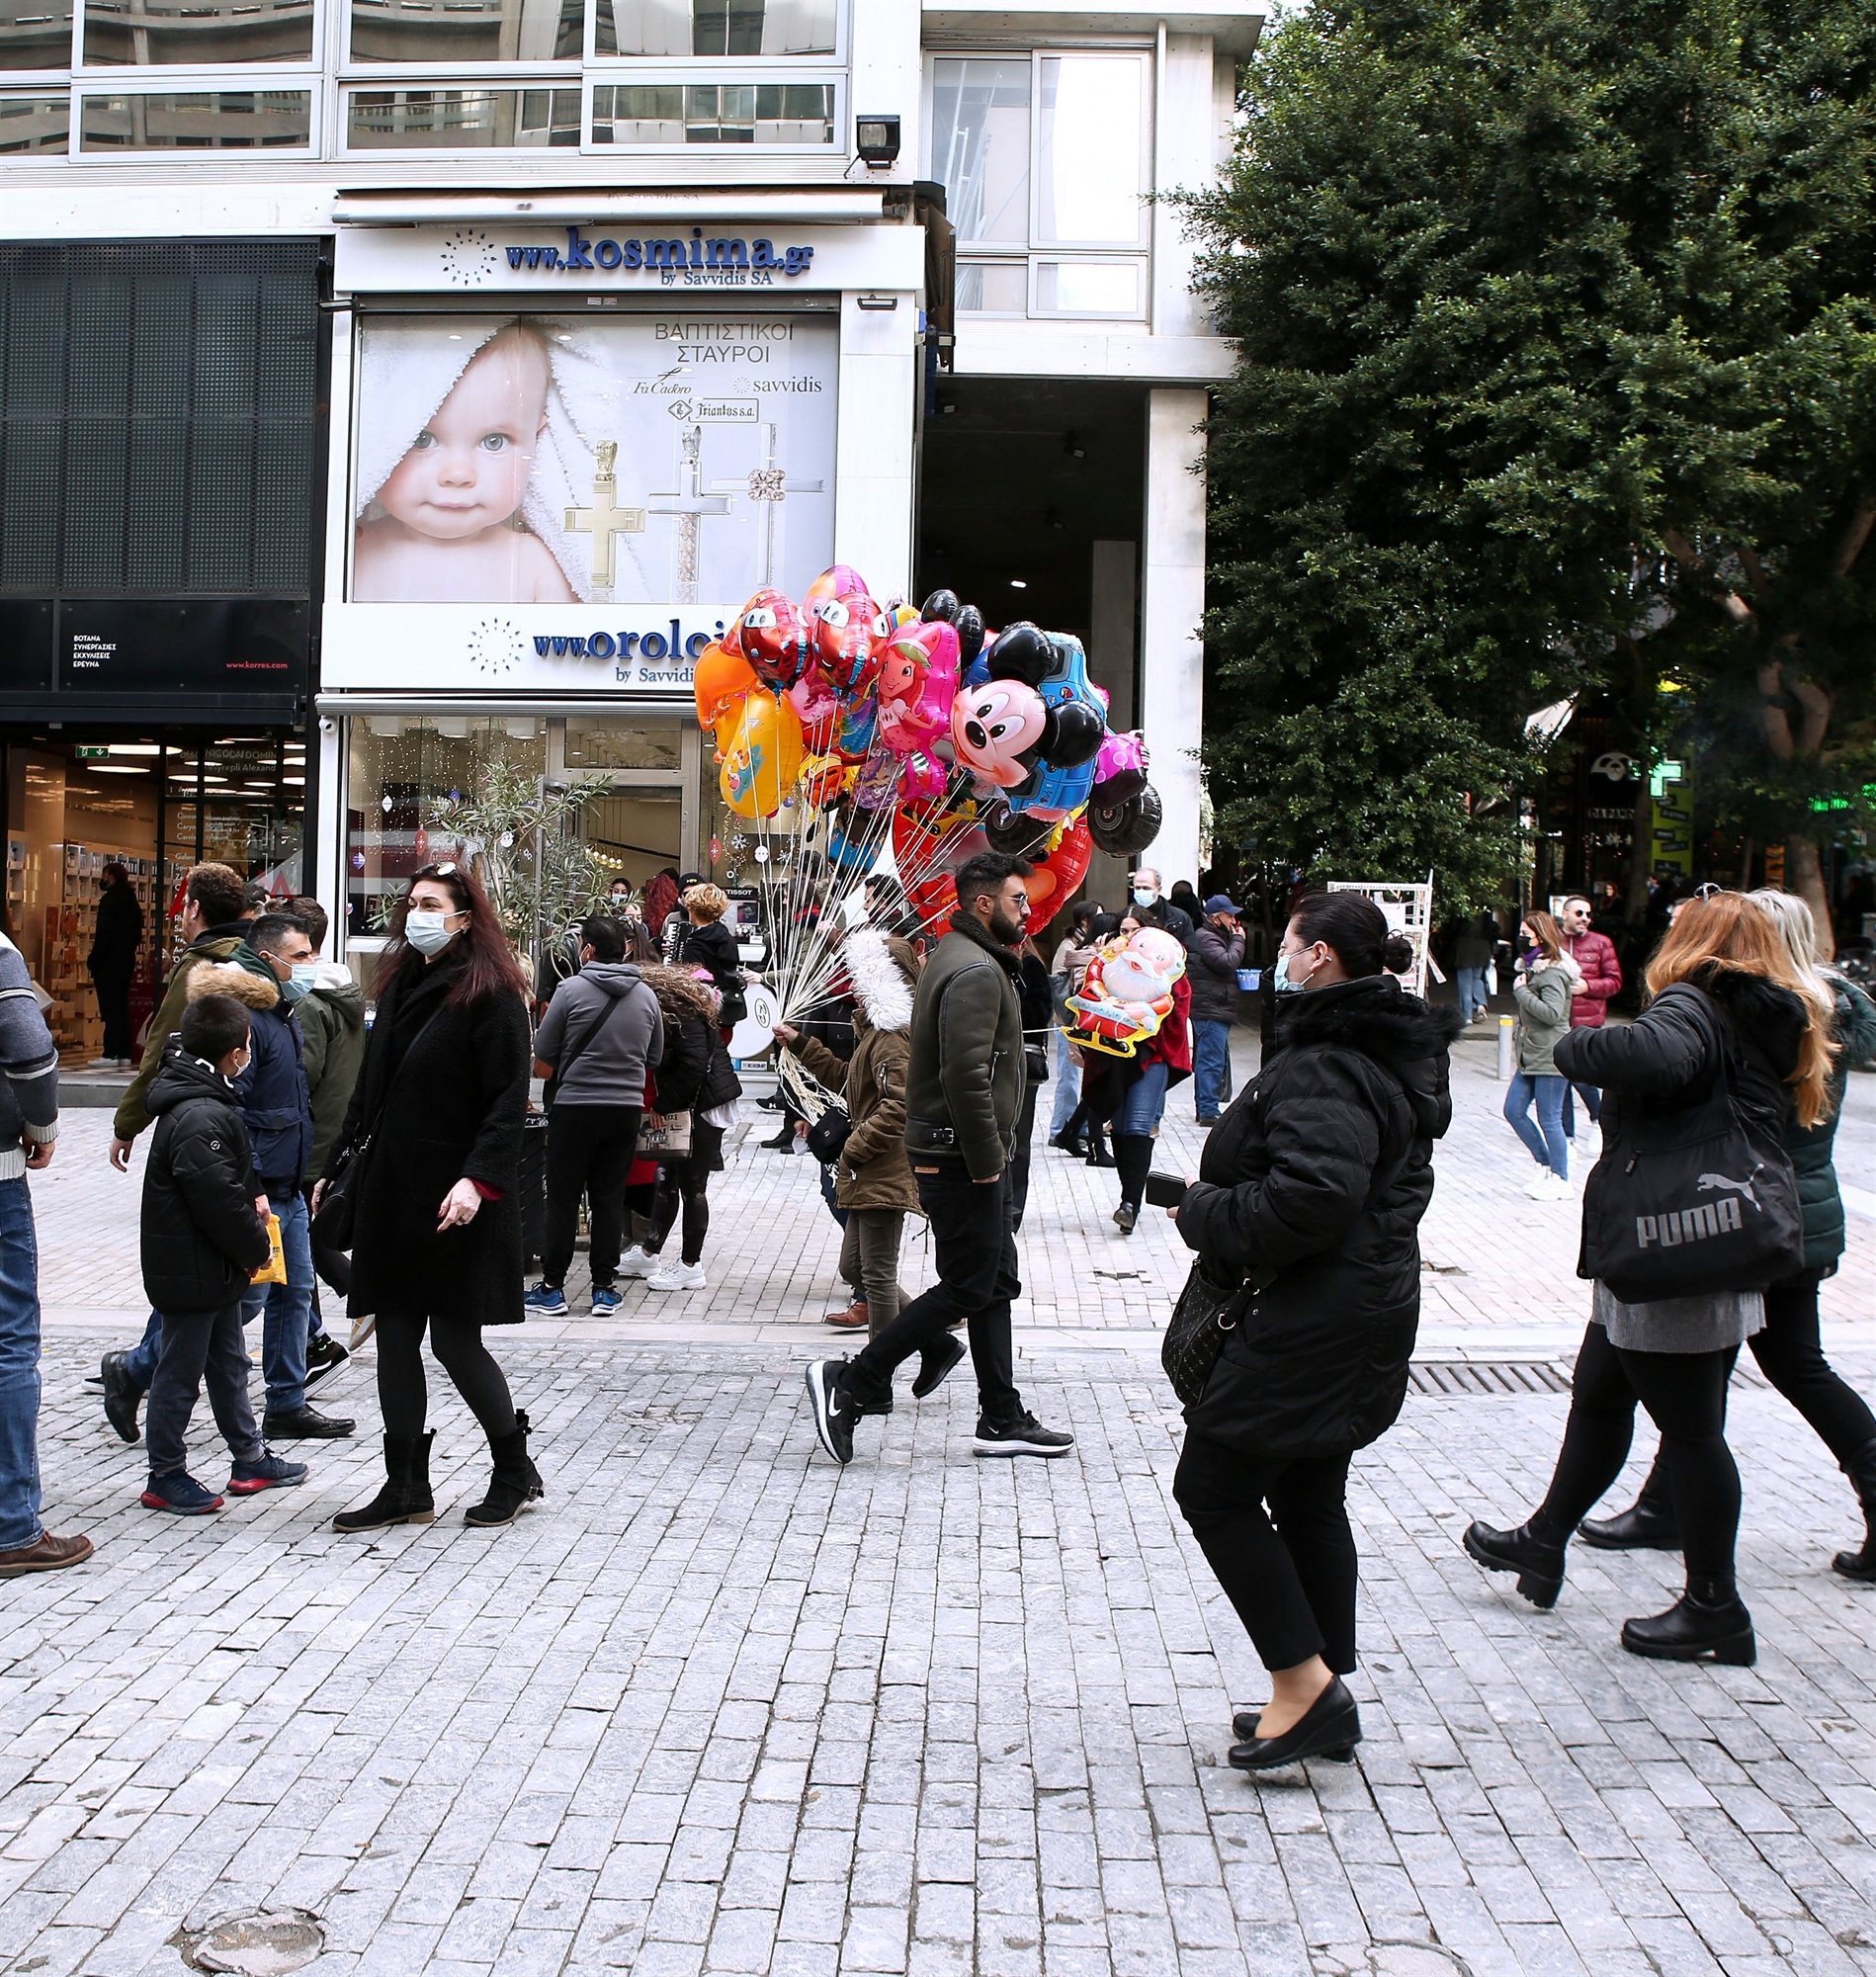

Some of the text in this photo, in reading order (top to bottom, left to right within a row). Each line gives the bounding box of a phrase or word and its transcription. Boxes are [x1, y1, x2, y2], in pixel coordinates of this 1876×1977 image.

[505, 225, 814, 277] www.kosmima.gr
[661, 271, 774, 287] by Savvidis SA
[654, 322, 794, 341] ΒΑΠΤΙΣΤΙΚΟΙ
[677, 345, 770, 363] ΣΤΑΥΡΟΙ
[752, 376, 822, 393] savvidis
[225, 660, 289, 669] www.korres.com
[616, 667, 694, 682] by Savvidi
[1636, 1197, 1743, 1248] PUMA
